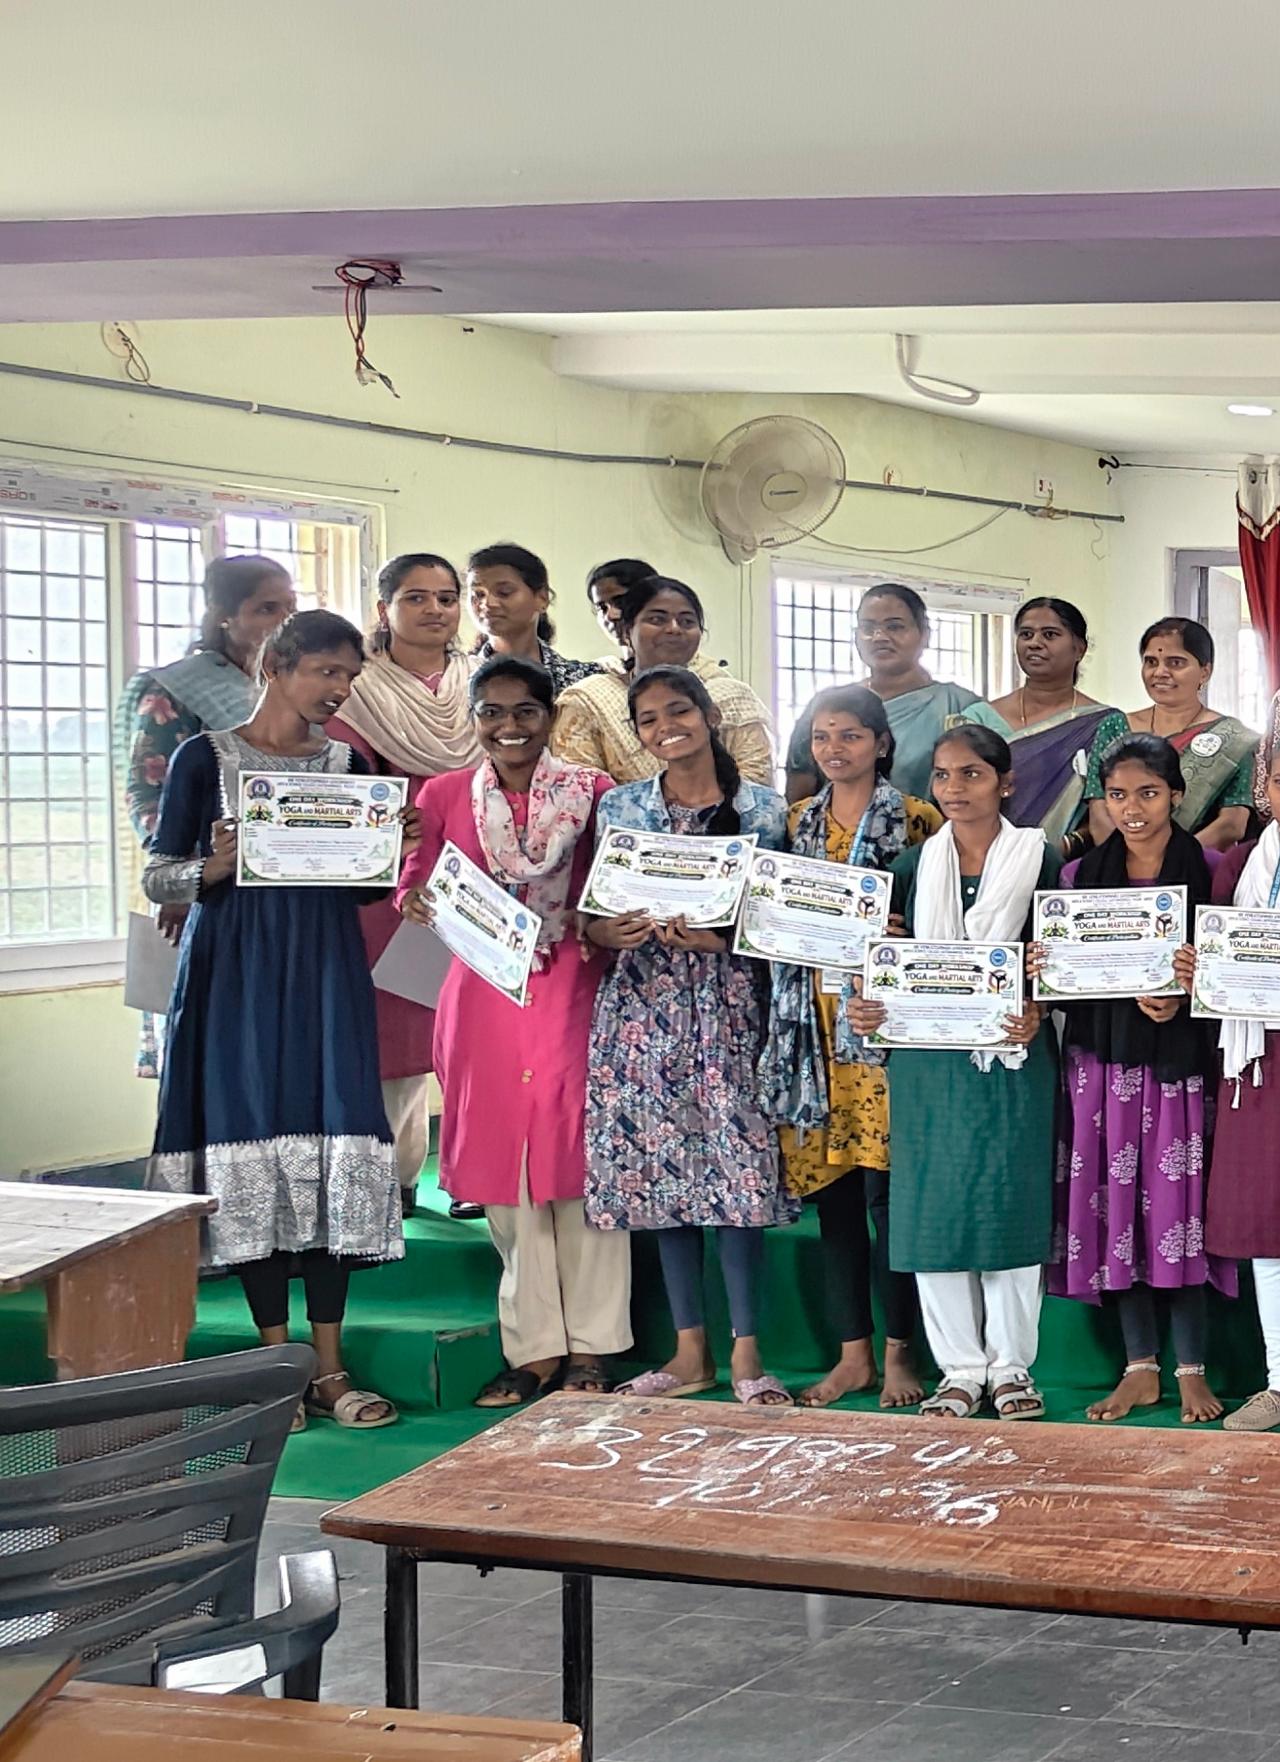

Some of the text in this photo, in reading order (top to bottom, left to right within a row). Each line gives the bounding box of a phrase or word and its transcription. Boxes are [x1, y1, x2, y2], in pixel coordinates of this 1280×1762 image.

[279, 806, 303, 814] YOGA
[314, 808, 343, 816] MARTIAL
[1074, 921, 1097, 929] YOGA
[1107, 921, 1133, 929] MARTIAL
[1229, 940, 1250, 948] YOGA
[905, 972, 927, 980] YOGA
[938, 974, 966, 982] MARTIAL
